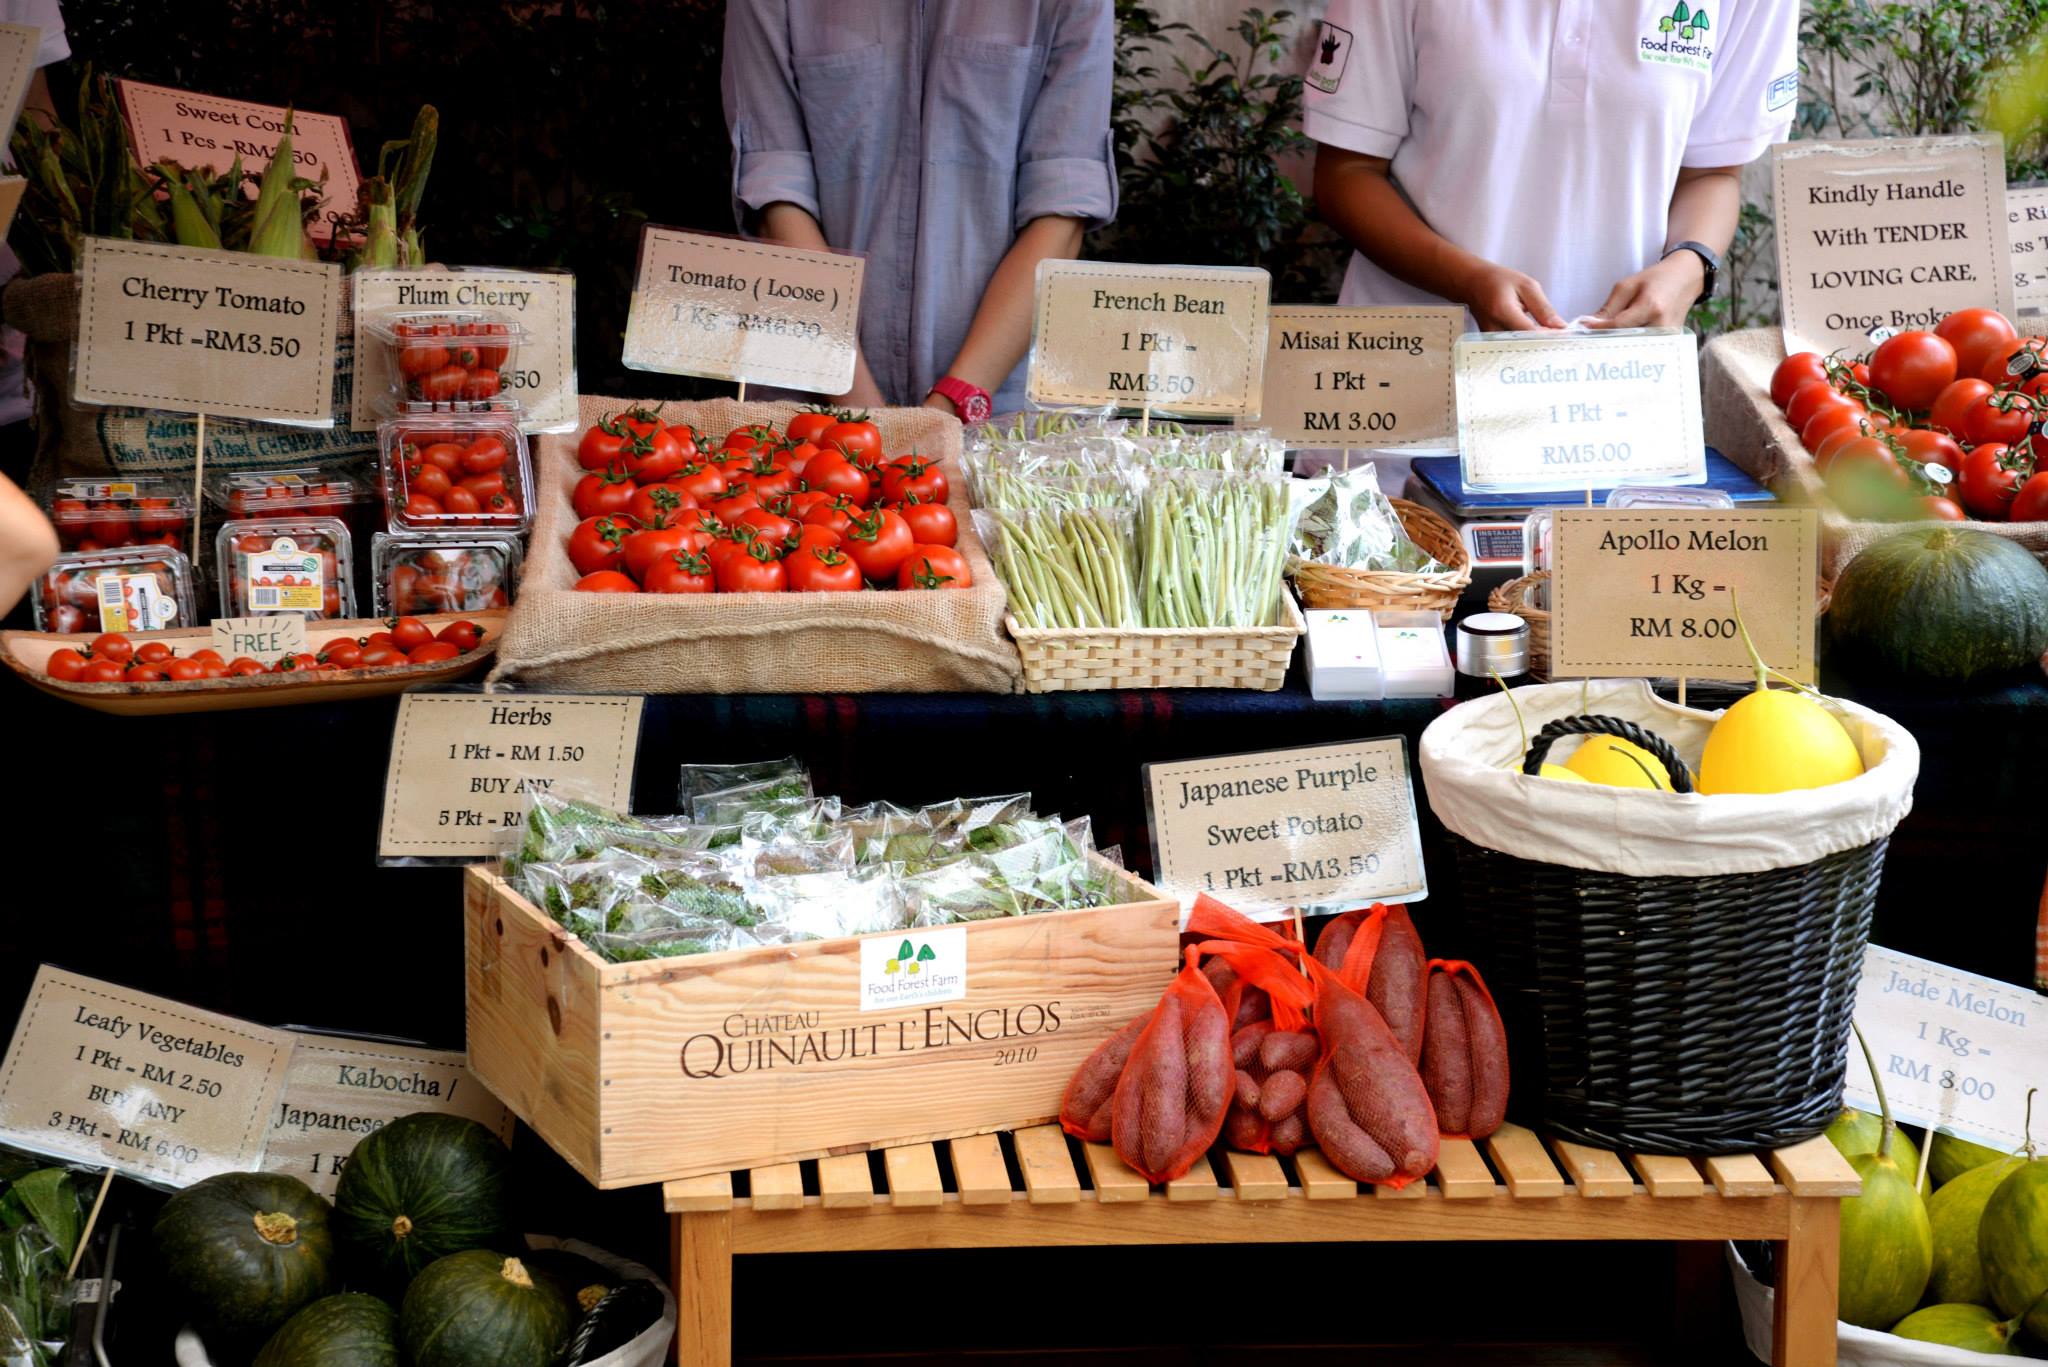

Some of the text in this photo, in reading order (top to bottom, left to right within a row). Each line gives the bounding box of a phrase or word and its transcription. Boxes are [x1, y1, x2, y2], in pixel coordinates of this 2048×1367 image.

[1640, 38, 1667, 52] Food
[1671, 41, 1701, 56] Forest
[176, 102, 301, 136] Sweet Corn
[162, 128, 174, 143] 1
[180, 131, 217, 150] Pcs
[1808, 180, 1965, 206] Kindly Handle
[1813, 222, 1968, 247] With TENDER
[668, 264, 747, 292] Tomato
[768, 278, 825, 303] Loose
[1811, 268, 1903, 289] LOVING
[122, 276, 306, 316] Cherry Tomato
[398, 284, 531, 312] Plum Cherry
[1092, 289, 1225, 316] French Bean
[673, 304, 681, 322] 1
[690, 305, 717, 332] Kg
[1826, 312, 1883, 331] Once
[124, 320, 134, 341] 1
[145, 322, 184, 346] Pkt
[1121, 332, 1129, 351] 1
[1139, 332, 1173, 352] Pkt
[1280, 330, 1424, 356] Misai Kucing
[1108, 371, 1195, 396] RM3.50
[1314, 371, 1322, 390] 1
[1332, 370, 1366, 391] Pkt
[1499, 360, 1665, 385] Garden Medley
[1303, 411, 1396, 431] RM 3.00
[1550, 405, 1558, 423] 1
[1567, 402, 1602, 423] Pkt
[1541, 442, 1631, 465] RM5.00
[1600, 529, 1768, 556] Apollo Melon
[1651, 574, 1660, 594] 1
[1672, 574, 1705, 600] Kg
[1630, 617, 1737, 638] RM 8.00
[233, 632, 282, 653] FREE
[490, 706, 552, 725] Herbs
[448, 744, 457, 759] 1
[463, 743, 492, 759] Pkt
[511, 745, 541, 760] RM
[547, 746, 584, 761] 1.50
[470, 777, 511, 794] BUY
[1179, 761, 1378, 809] Japanese Purple
[439, 810, 450, 826] 5
[454, 809, 483, 826] Pkt
[1207, 813, 1364, 847] Sweet Potato
[1204, 871, 1216, 891] 1
[1225, 866, 1263, 890] Pkt
[868, 974, 958, 996] Food Forest Farm
[1884, 970, 2026, 1027] Jade Melon
[74, 1006, 244, 1068] Leafy Vegetables
[1917, 1022, 1928, 1040] 1
[1937, 1026, 1972, 1057] Kg
[681, 1023, 886, 1079] QUINAULT
[993, 1046, 1038, 1067] 2010
[75, 1045, 86, 1061] 1
[90, 1048, 123, 1071] Pkt
[141, 1063, 175, 1086] RM
[179, 1074, 222, 1098] 2.50
[337, 1065, 441, 1097] Kabocha
[1888, 1054, 1995, 1101] RM 8.00
[139, 1102, 186, 1124] ANY
[274, 1103, 384, 1134] Japanese
[48, 1111, 62, 1127] 3
[66, 1115, 98, 1137] Pkt
[117, 1128, 152, 1151] RM
[156, 1140, 199, 1164] 6.00
[310, 1153, 349, 1176] 1 K
